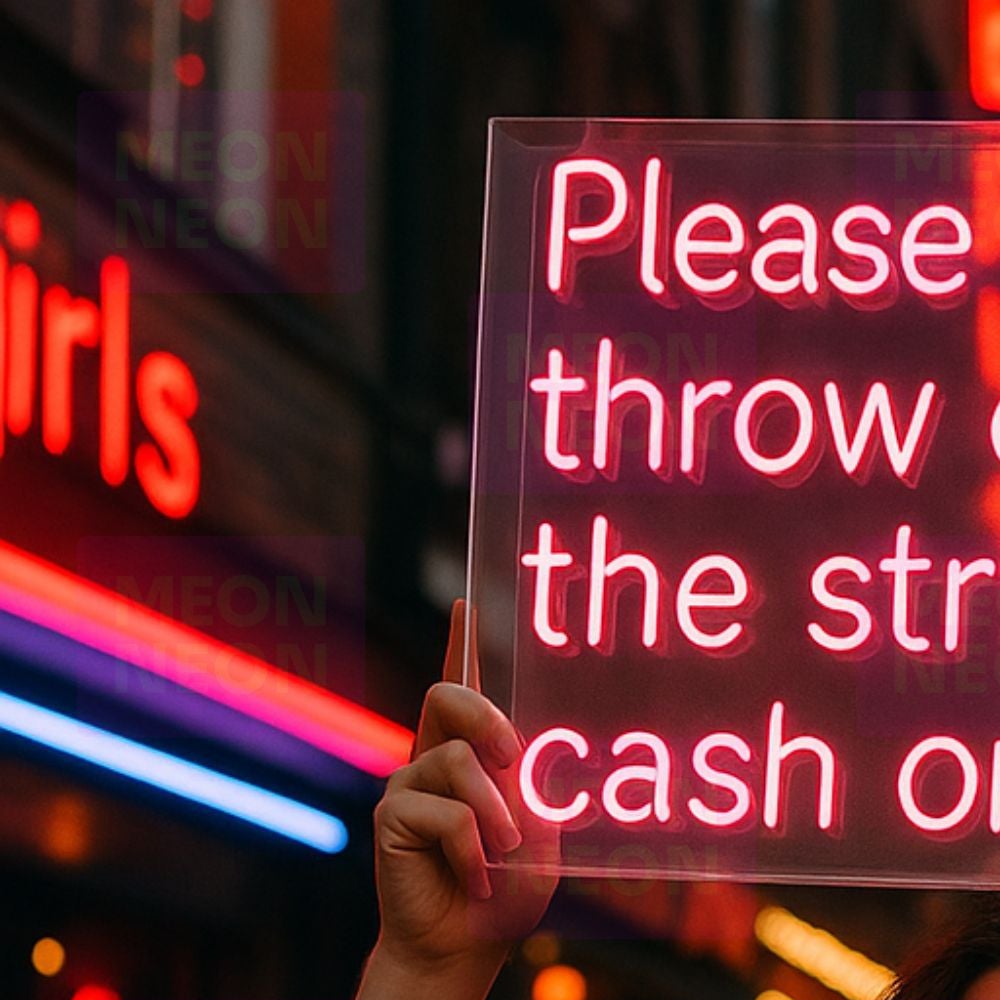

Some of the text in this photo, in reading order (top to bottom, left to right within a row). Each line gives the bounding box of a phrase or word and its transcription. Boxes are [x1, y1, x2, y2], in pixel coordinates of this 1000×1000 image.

[546, 157, 974, 299] Please
[0, 199, 200, 520] irls
[529, 337, 938, 478] throw
[520, 514, 750, 650] the
[518, 700, 836, 831] cash
